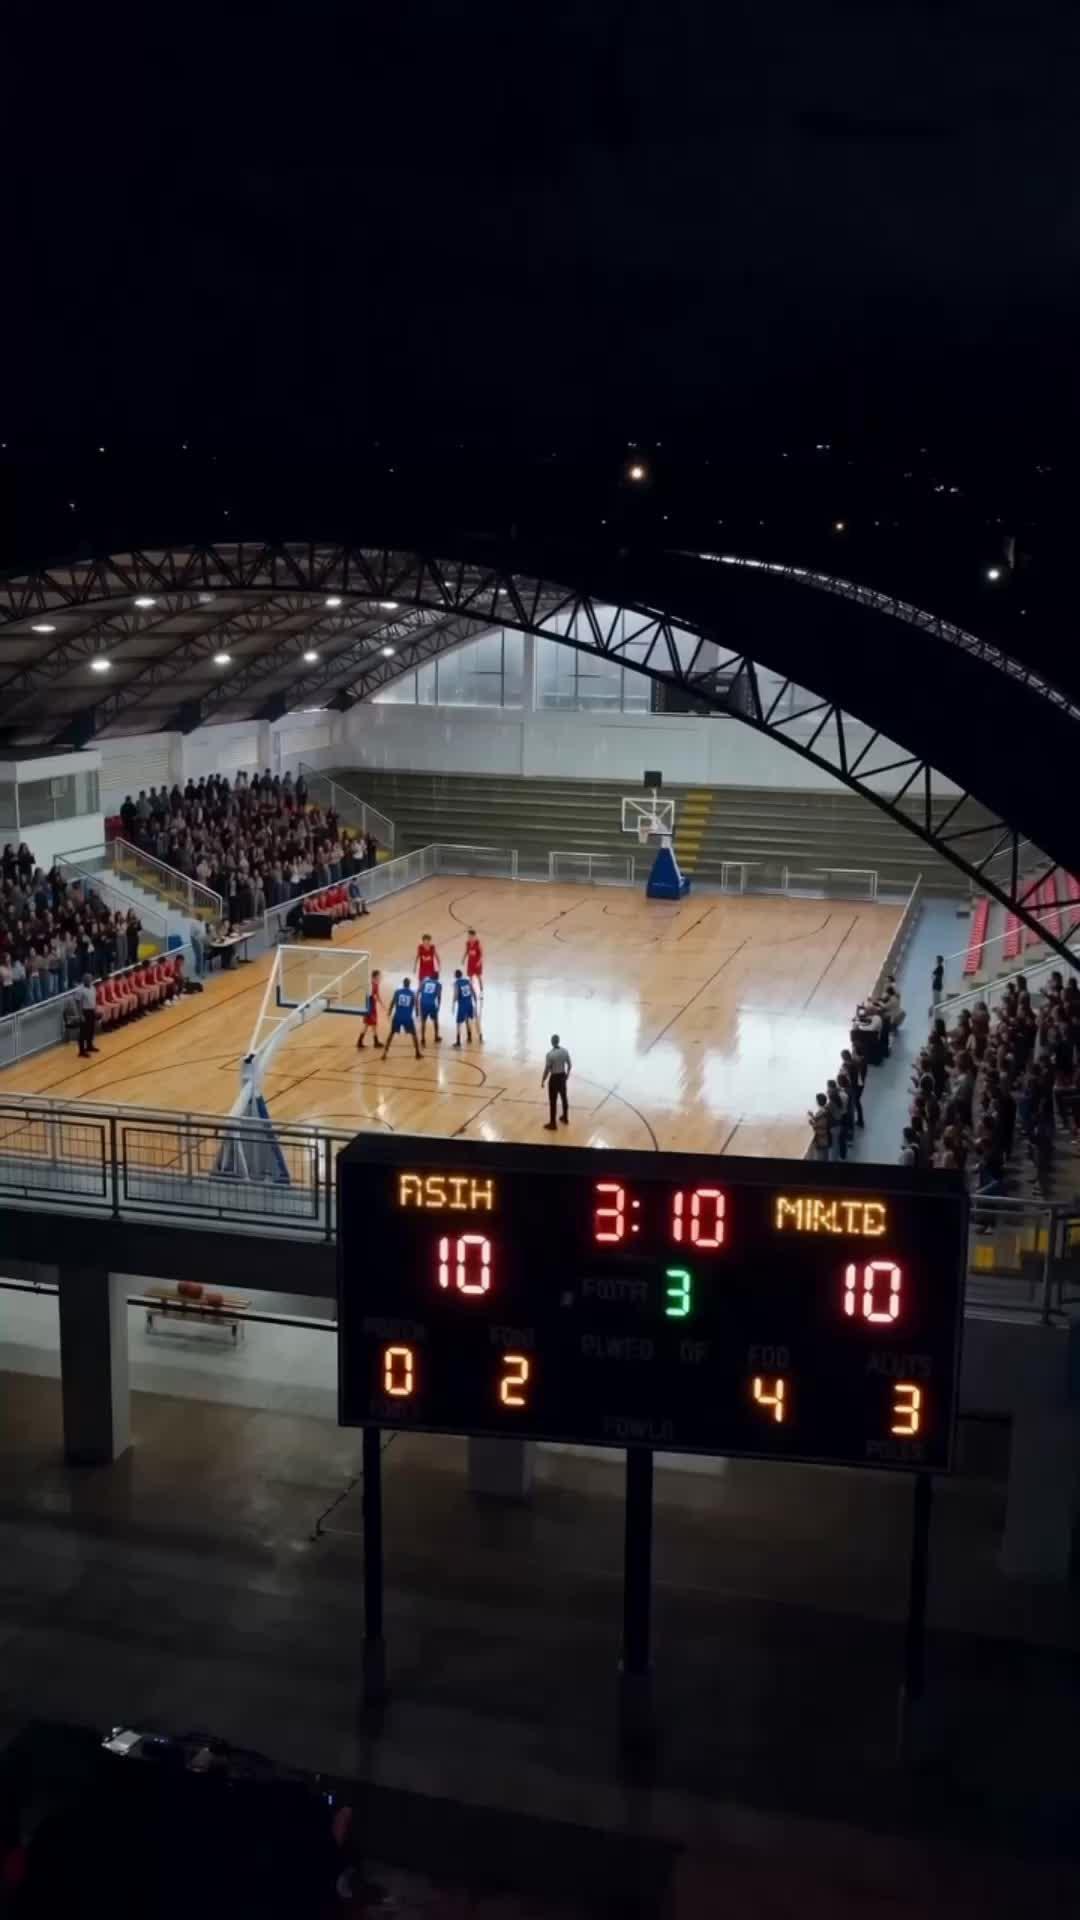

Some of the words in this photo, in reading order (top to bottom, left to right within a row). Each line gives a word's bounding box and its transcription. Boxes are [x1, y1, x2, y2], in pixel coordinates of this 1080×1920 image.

[438, 1234, 491, 1295] 10
[666, 1269, 691, 1316] 3
[844, 1260, 902, 1323] 10
[384, 1347, 413, 1396] 0
[500, 1355, 529, 1406] 2
[753, 1377, 784, 1422] 4
[891, 1384, 921, 1435] 3
